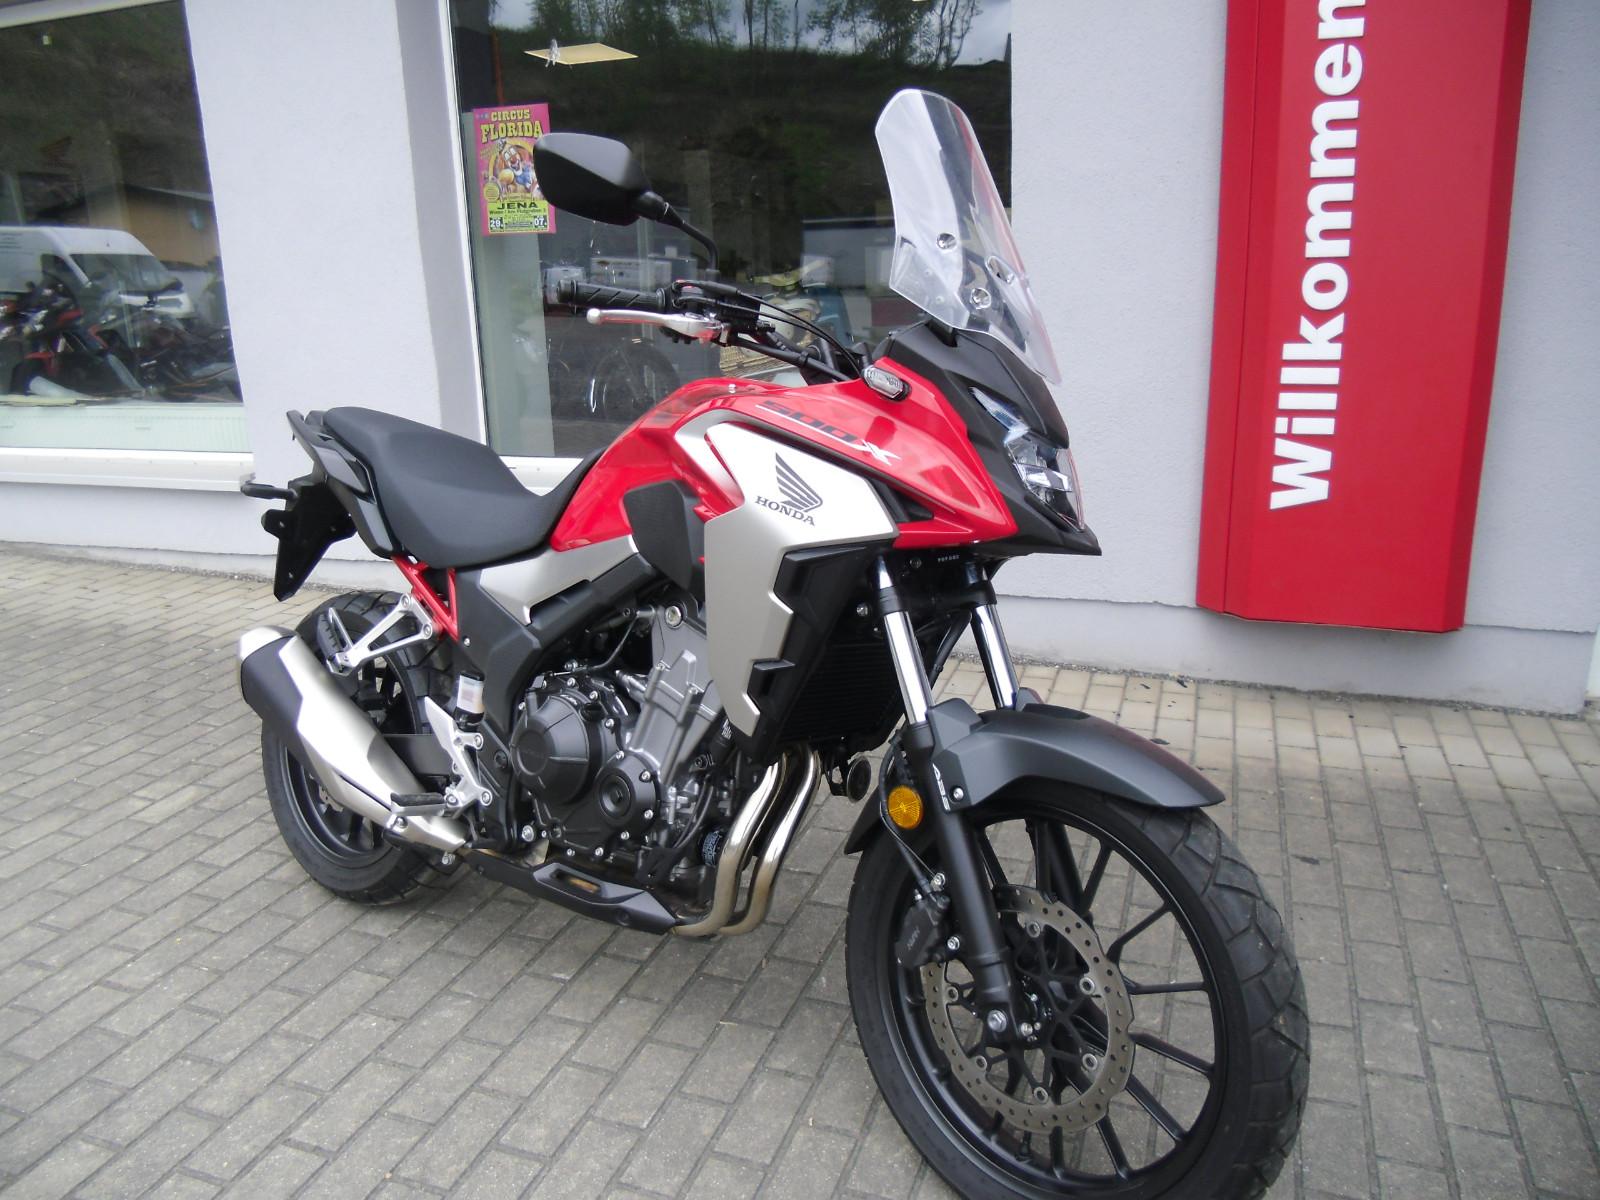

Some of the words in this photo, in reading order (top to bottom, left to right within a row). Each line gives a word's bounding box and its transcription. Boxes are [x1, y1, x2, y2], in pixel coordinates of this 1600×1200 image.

[491, 109, 530, 121] CIRCUS
[480, 120, 543, 144] FLORIDA
[497, 202, 538, 210] JENA
[1268, 0, 1366, 511] Willkommen
[755, 495, 816, 527] HONDA
